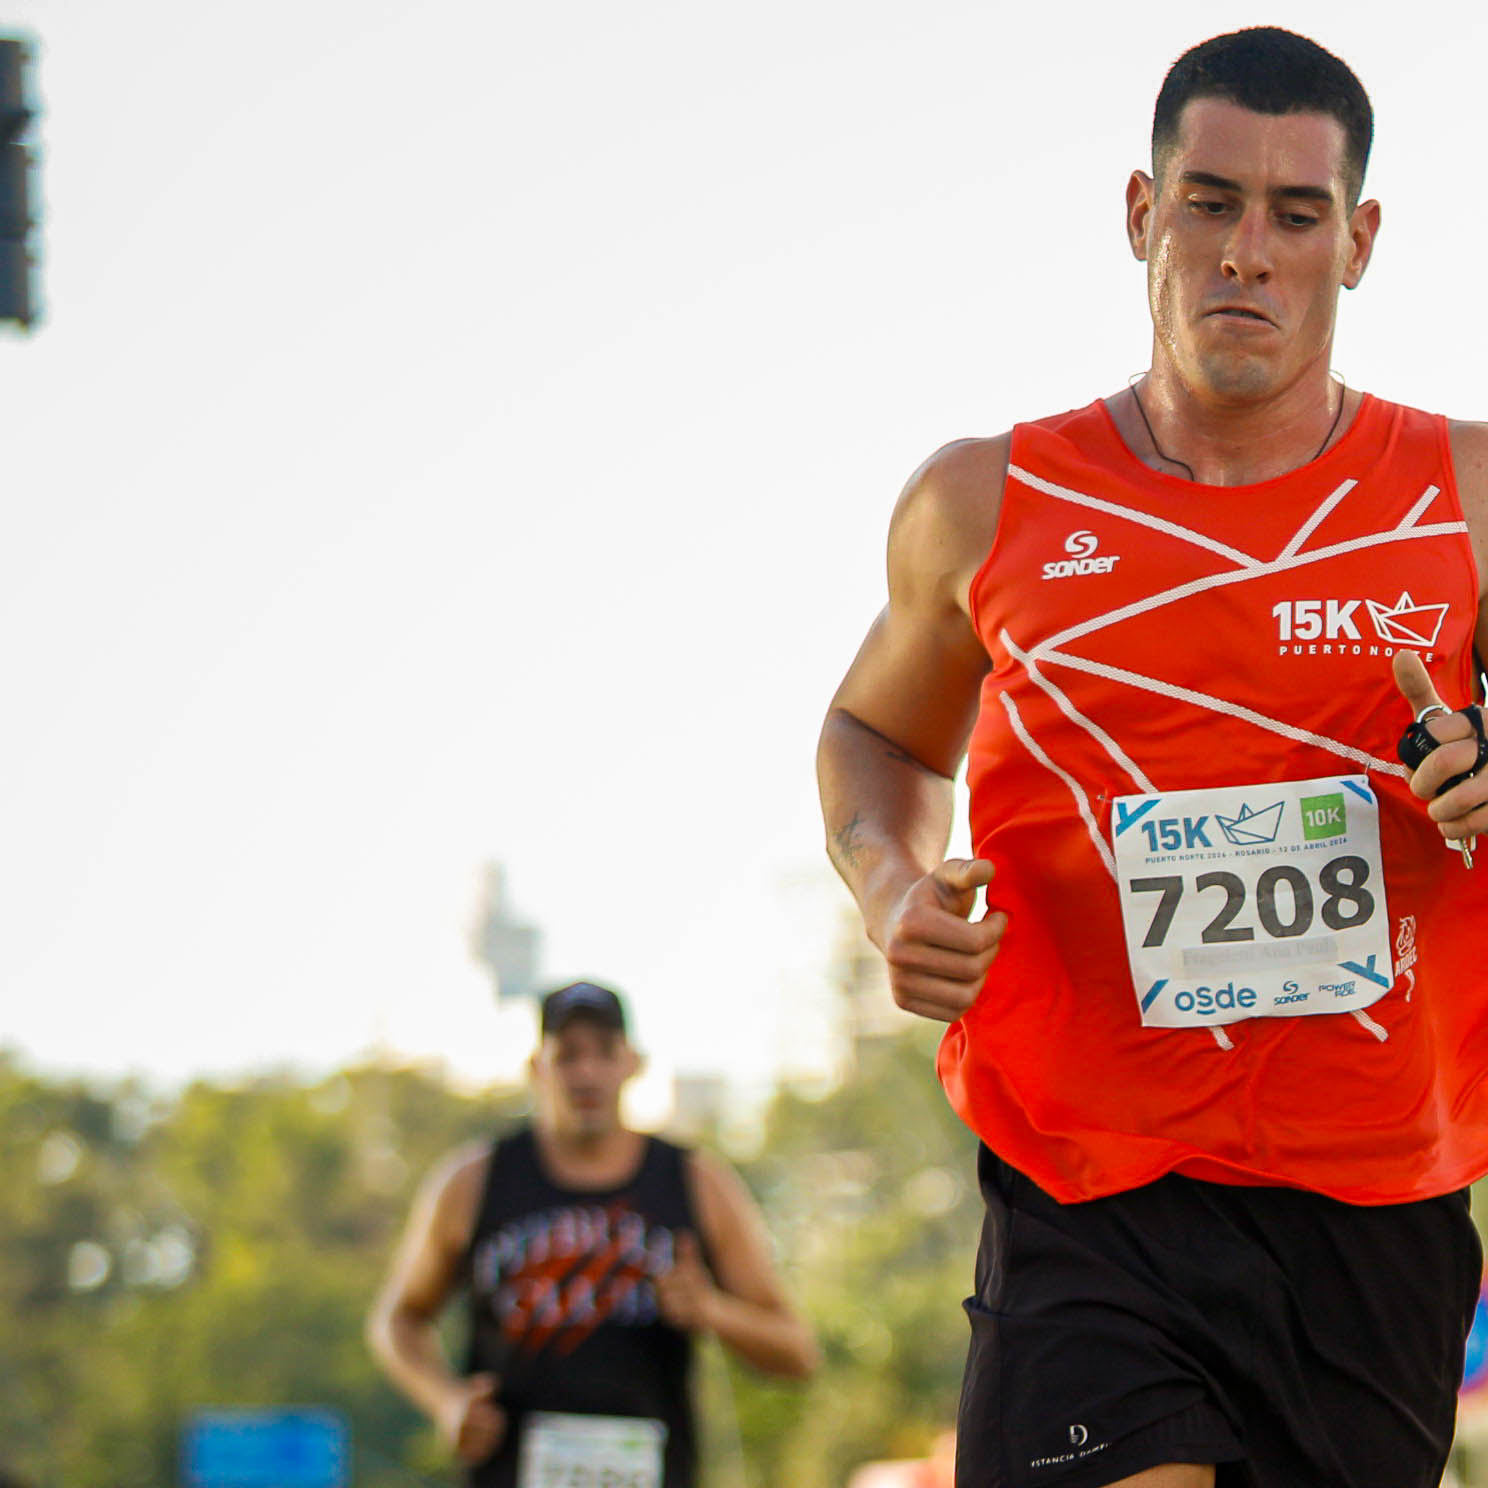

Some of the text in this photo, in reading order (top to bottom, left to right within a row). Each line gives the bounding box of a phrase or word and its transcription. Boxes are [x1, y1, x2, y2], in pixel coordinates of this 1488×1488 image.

[1272, 599, 1362, 641] 15K
[1279, 644, 1434, 663] PUERTO NOE
[1141, 815, 1213, 852] 15K
[1305, 807, 1342, 828] 10K
[1235, 848, 1270, 857] ROSARIO
[1130, 855, 1375, 948] 7208
[1174, 982, 1257, 1015] osde
